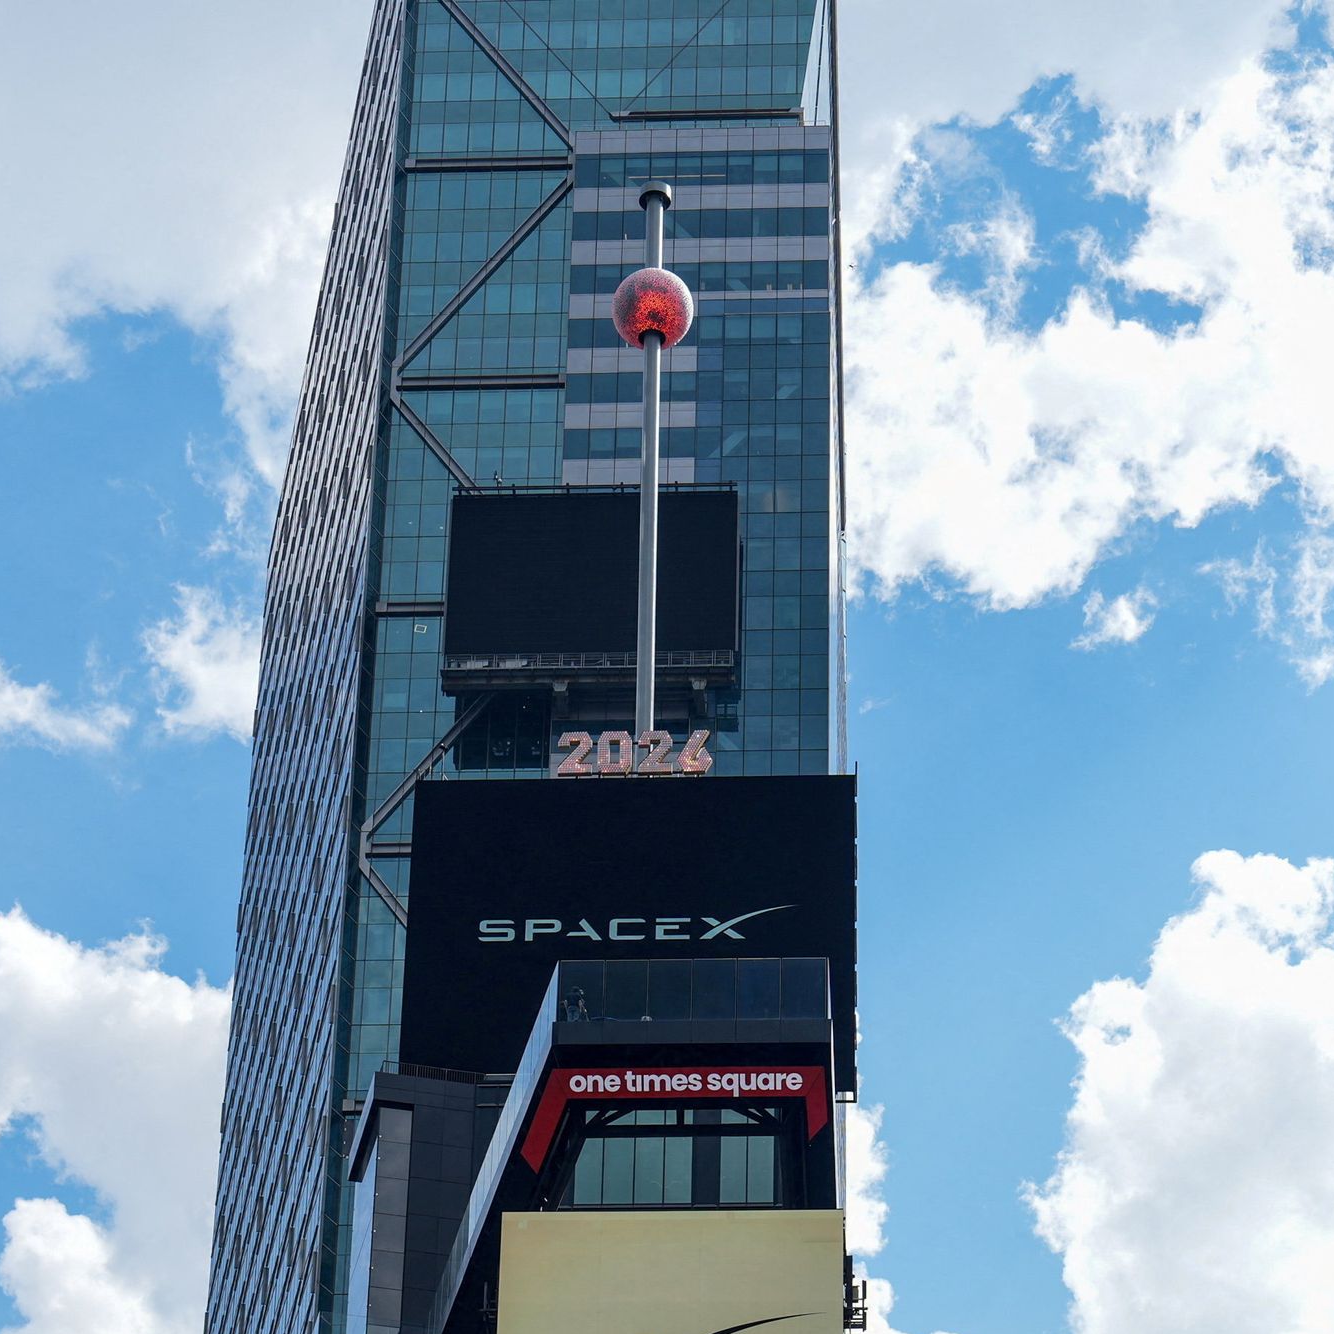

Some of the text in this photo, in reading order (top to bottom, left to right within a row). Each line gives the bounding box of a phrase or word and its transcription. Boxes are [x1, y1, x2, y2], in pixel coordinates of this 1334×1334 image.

[557, 729, 713, 777] 2026
[477, 903, 798, 942] SPACEX
[569, 1070, 803, 1098] one times square
